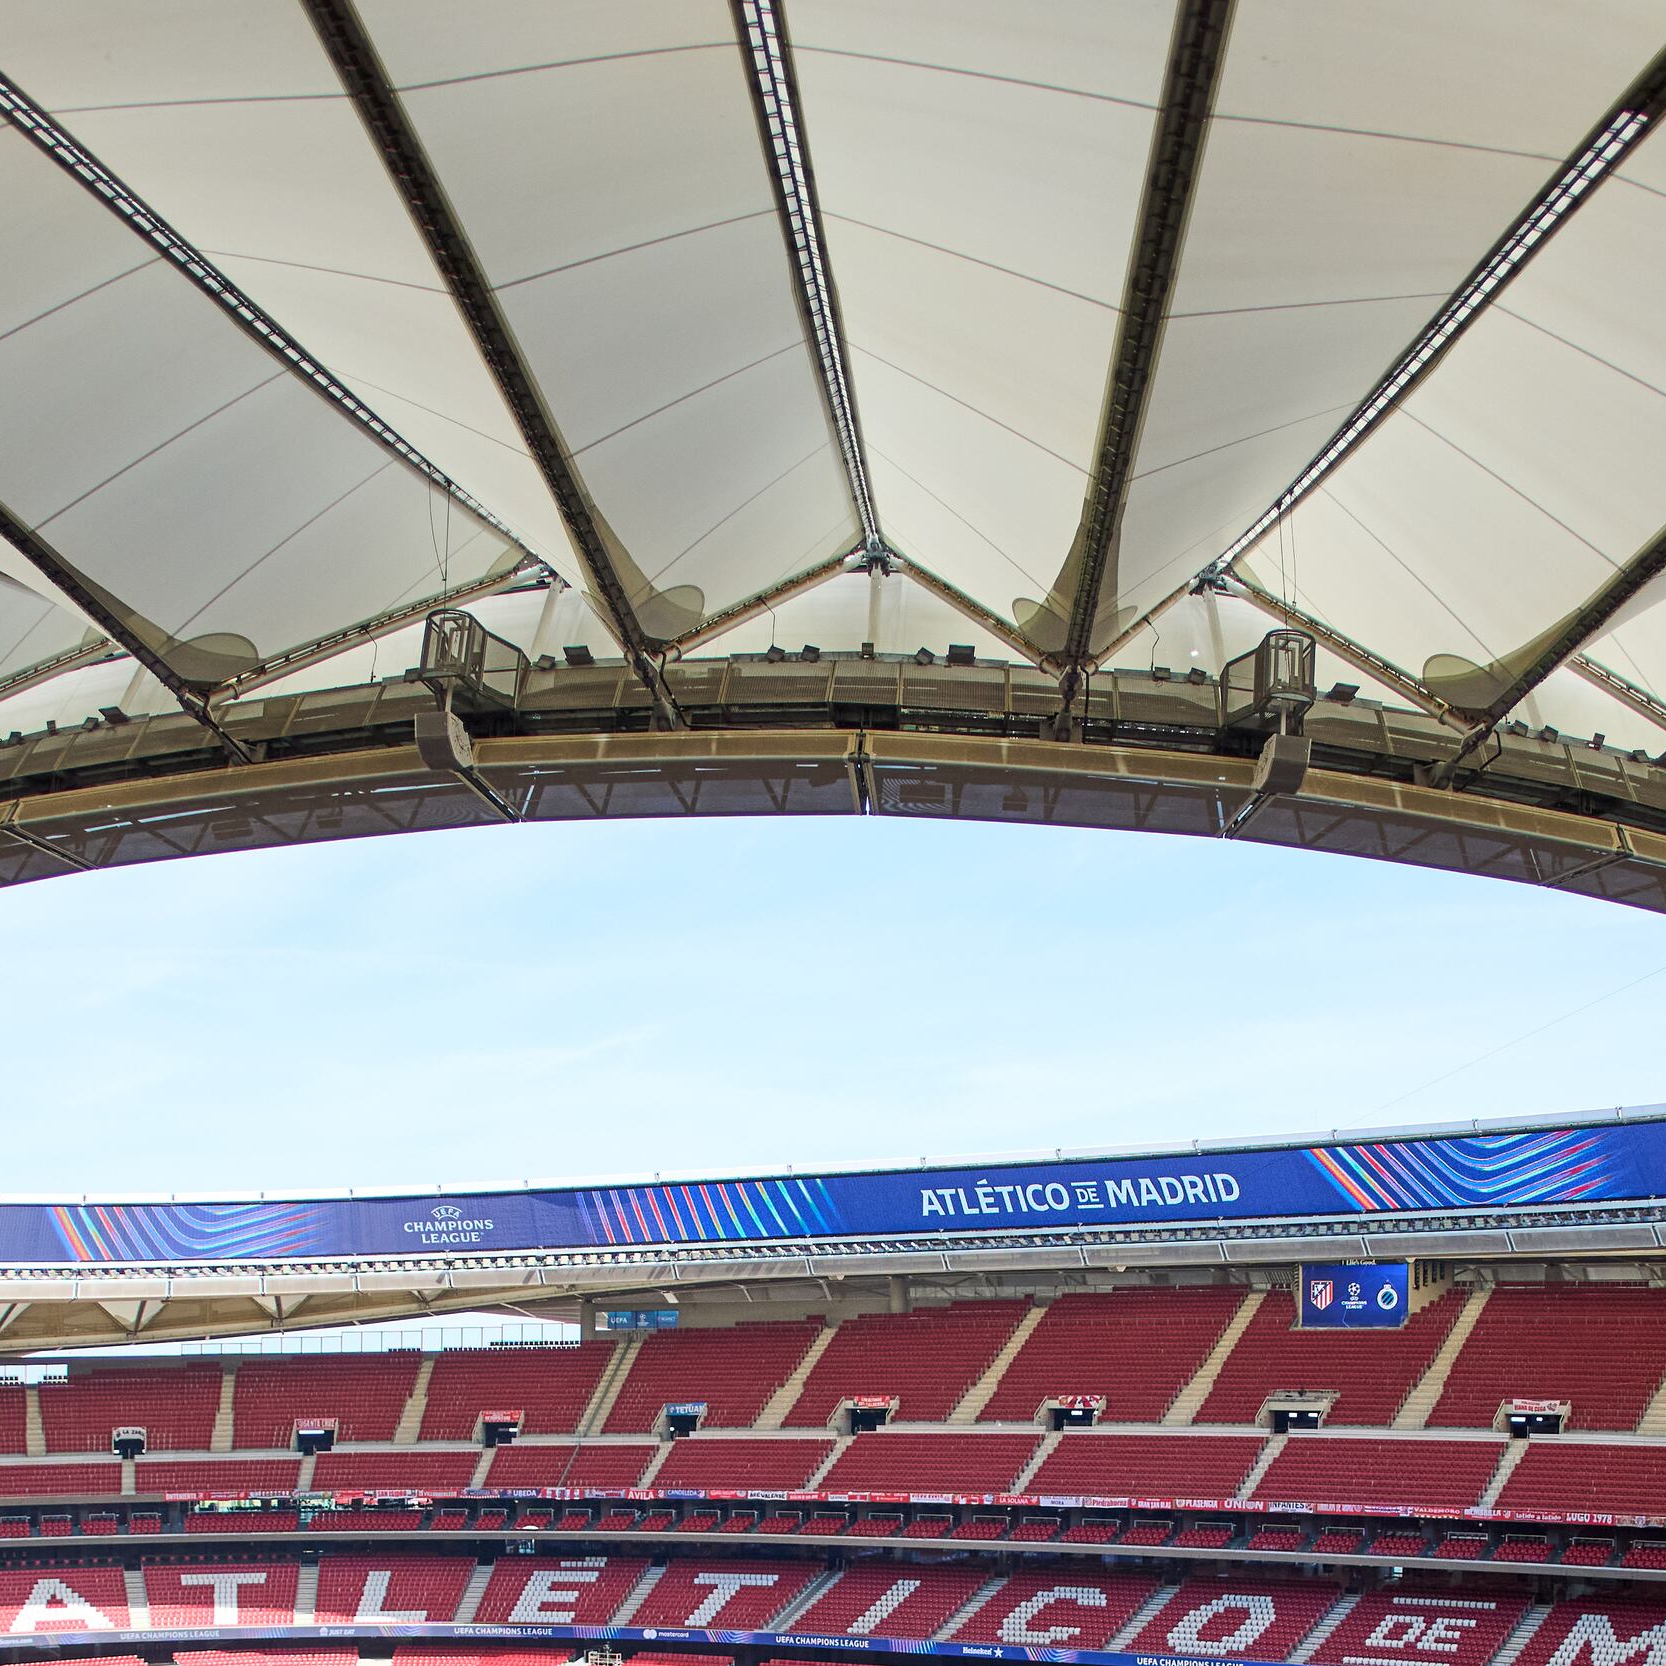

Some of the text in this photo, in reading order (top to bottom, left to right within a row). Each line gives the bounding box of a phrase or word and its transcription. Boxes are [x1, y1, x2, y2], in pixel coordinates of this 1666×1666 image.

[921, 1173, 1240, 1216] ATLÉTICO DE MADRID
[433, 1207, 460, 1218] UEFA
[404, 1219, 494, 1233] CHAMPIONS
[421, 1232, 481, 1244] LEAGUE
[610, 1316, 628, 1324] UEFA
[1566, 1513, 1613, 1523] LUGO 1978
[9, 1556, 1277, 1656] ATLÉTICO
[141, 1631, 189, 1639] CHAMPIONS
[190, 1630, 220, 1638] LEAGUE
[475, 1627, 522, 1635] CHAMPIONS
[523, 1628, 553, 1636] LEAGUE
[776, 1636, 870, 1648] UEFA CHAMPIONS LEAGUE
[962, 1646, 993, 1655] Heineken
[1136, 1657, 1158, 1666] UEFA
